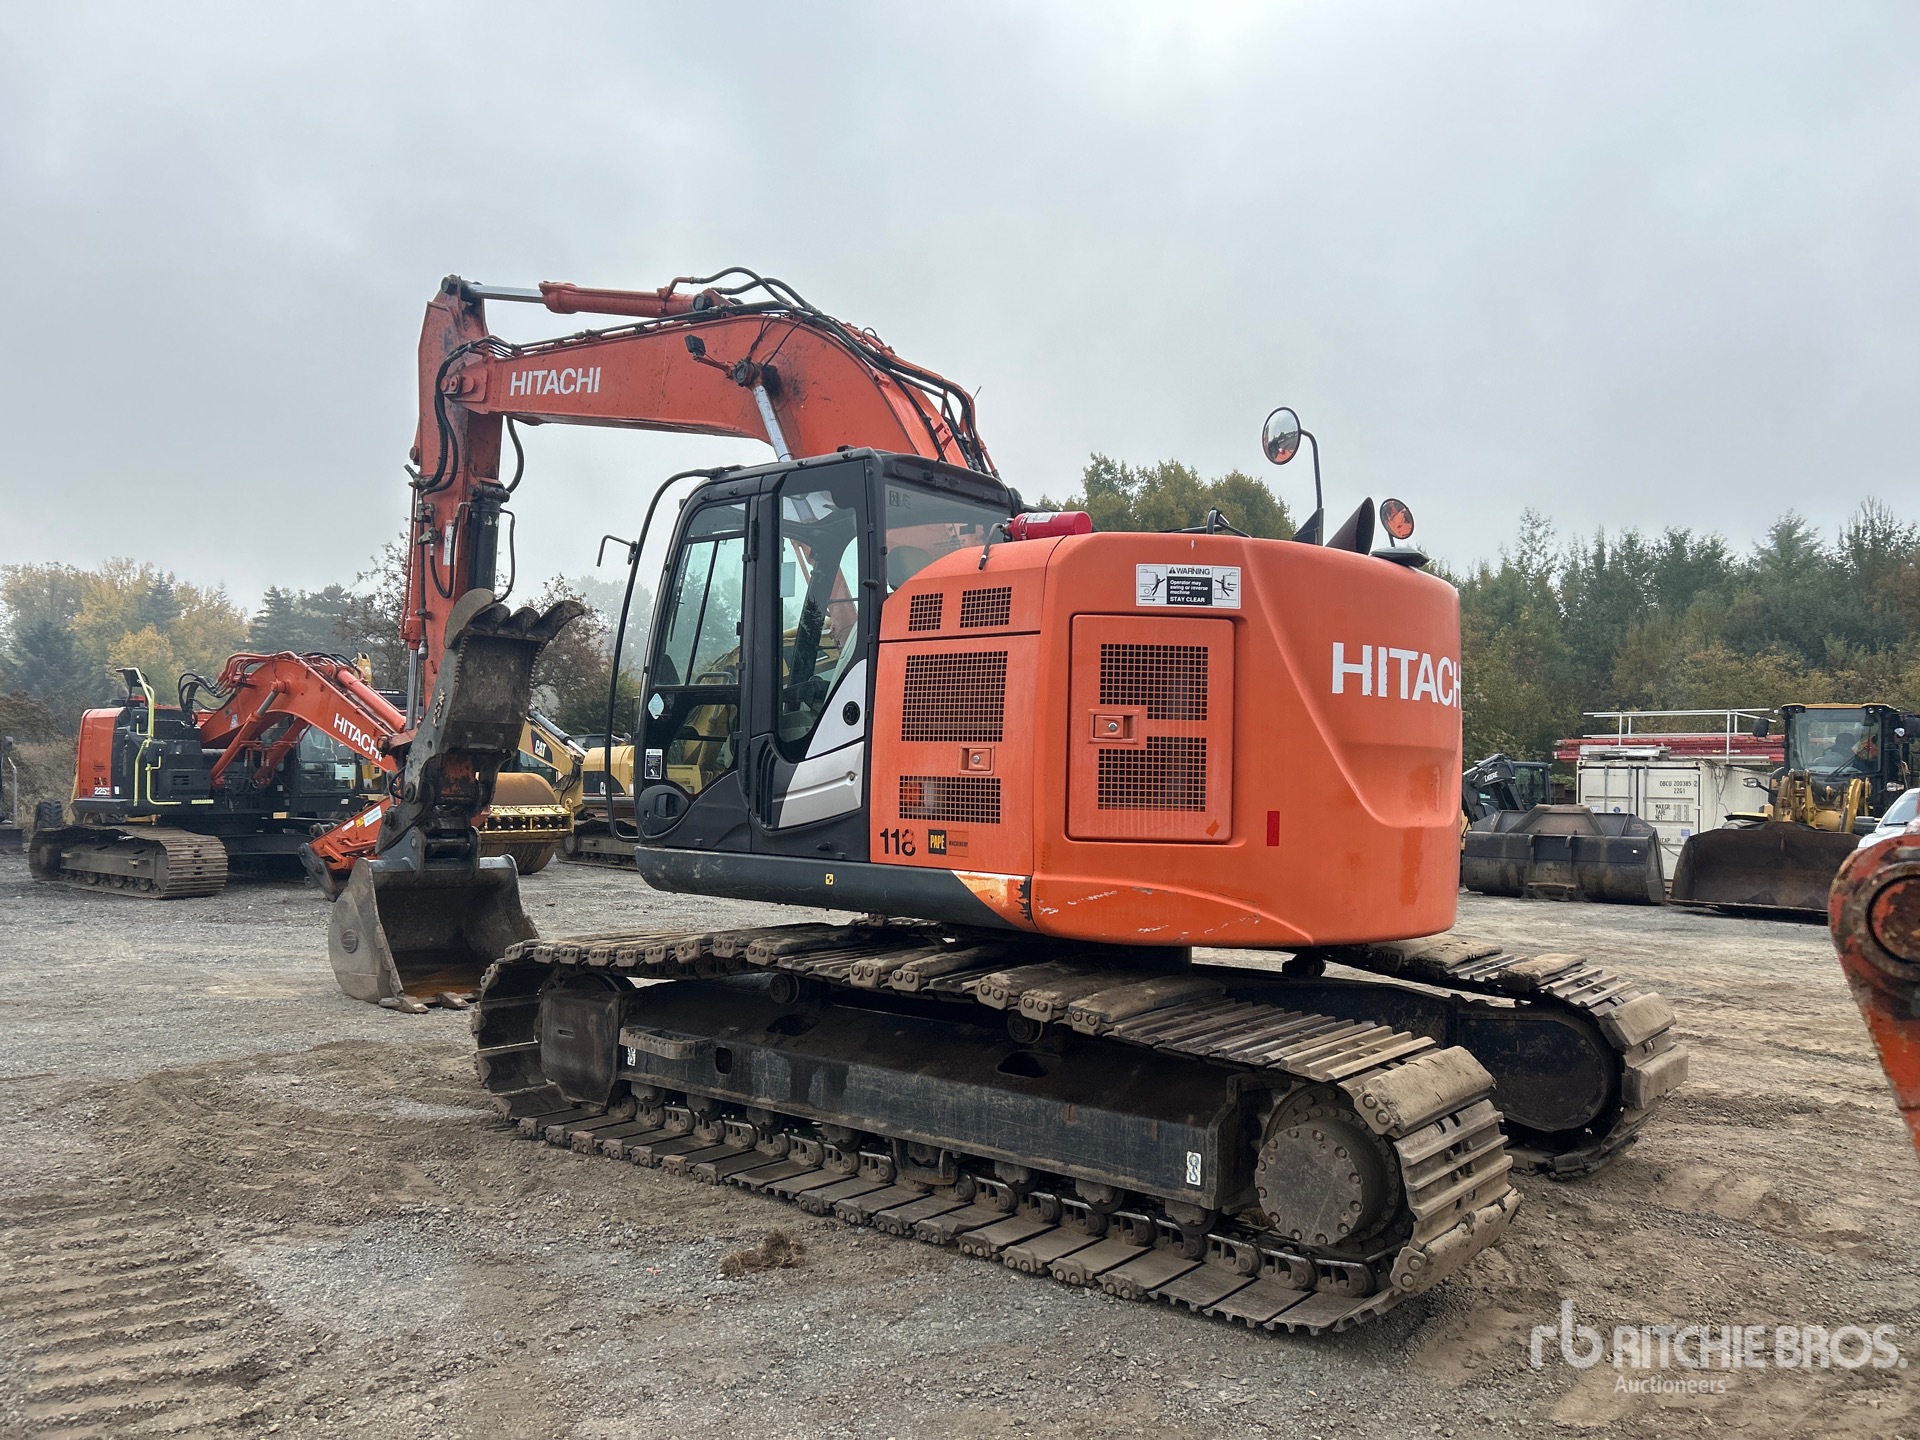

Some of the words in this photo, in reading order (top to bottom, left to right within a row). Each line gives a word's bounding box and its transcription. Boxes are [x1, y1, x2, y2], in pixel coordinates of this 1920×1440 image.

[510, 367, 601, 396] HITACHI
[1176, 567, 1210, 575] WARNING
[1331, 641, 1461, 709] HITACH
[534, 739, 547, 757] CAT
[94, 786, 107, 796] 225
